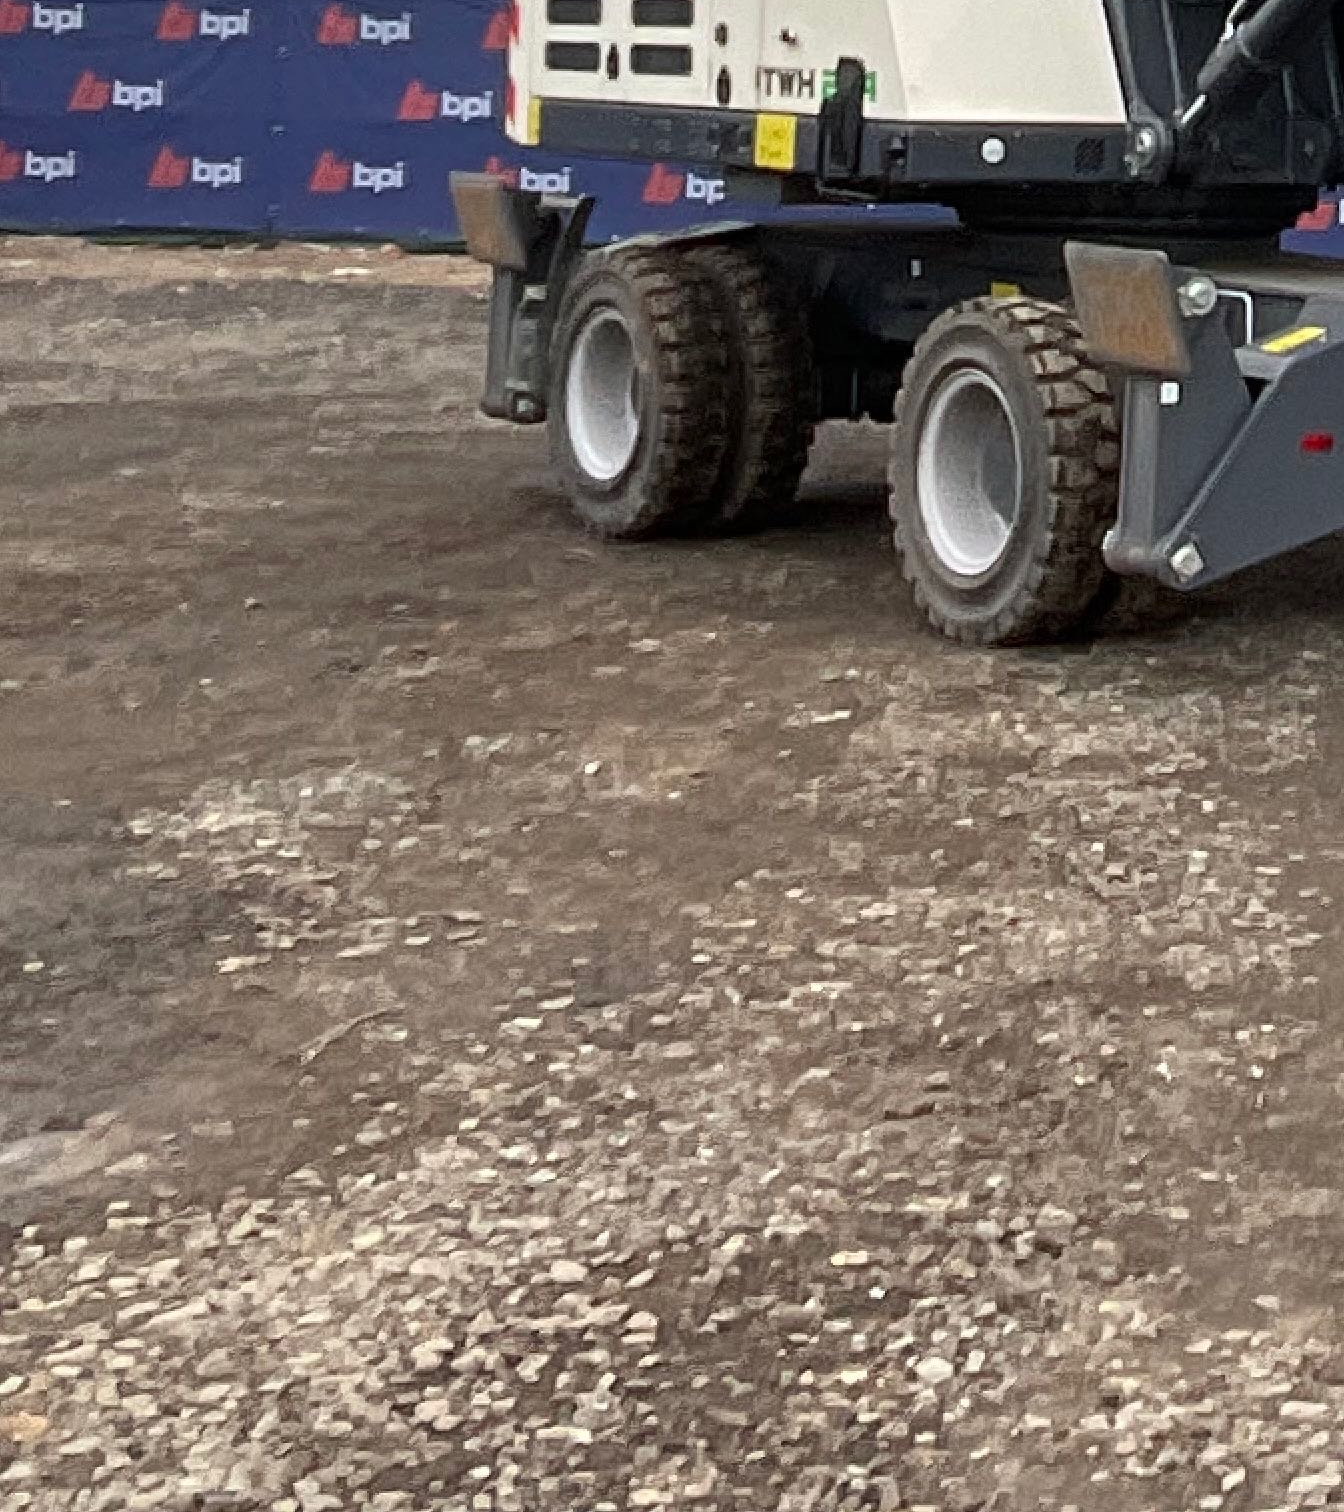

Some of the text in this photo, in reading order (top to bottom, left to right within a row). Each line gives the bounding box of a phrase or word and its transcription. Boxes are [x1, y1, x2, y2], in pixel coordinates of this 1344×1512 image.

[32, 2, 84, 34] bpi
[200, 8, 251, 40] bpi
[360, 14, 410, 46] bpi
[112, 79, 164, 112] bpi
[441, 90, 493, 122] bpi
[24, 150, 76, 182] bpi
[192, 156, 242, 188] bpi
[352, 162, 404, 194] bpi
[686, 172, 726, 205] bp
